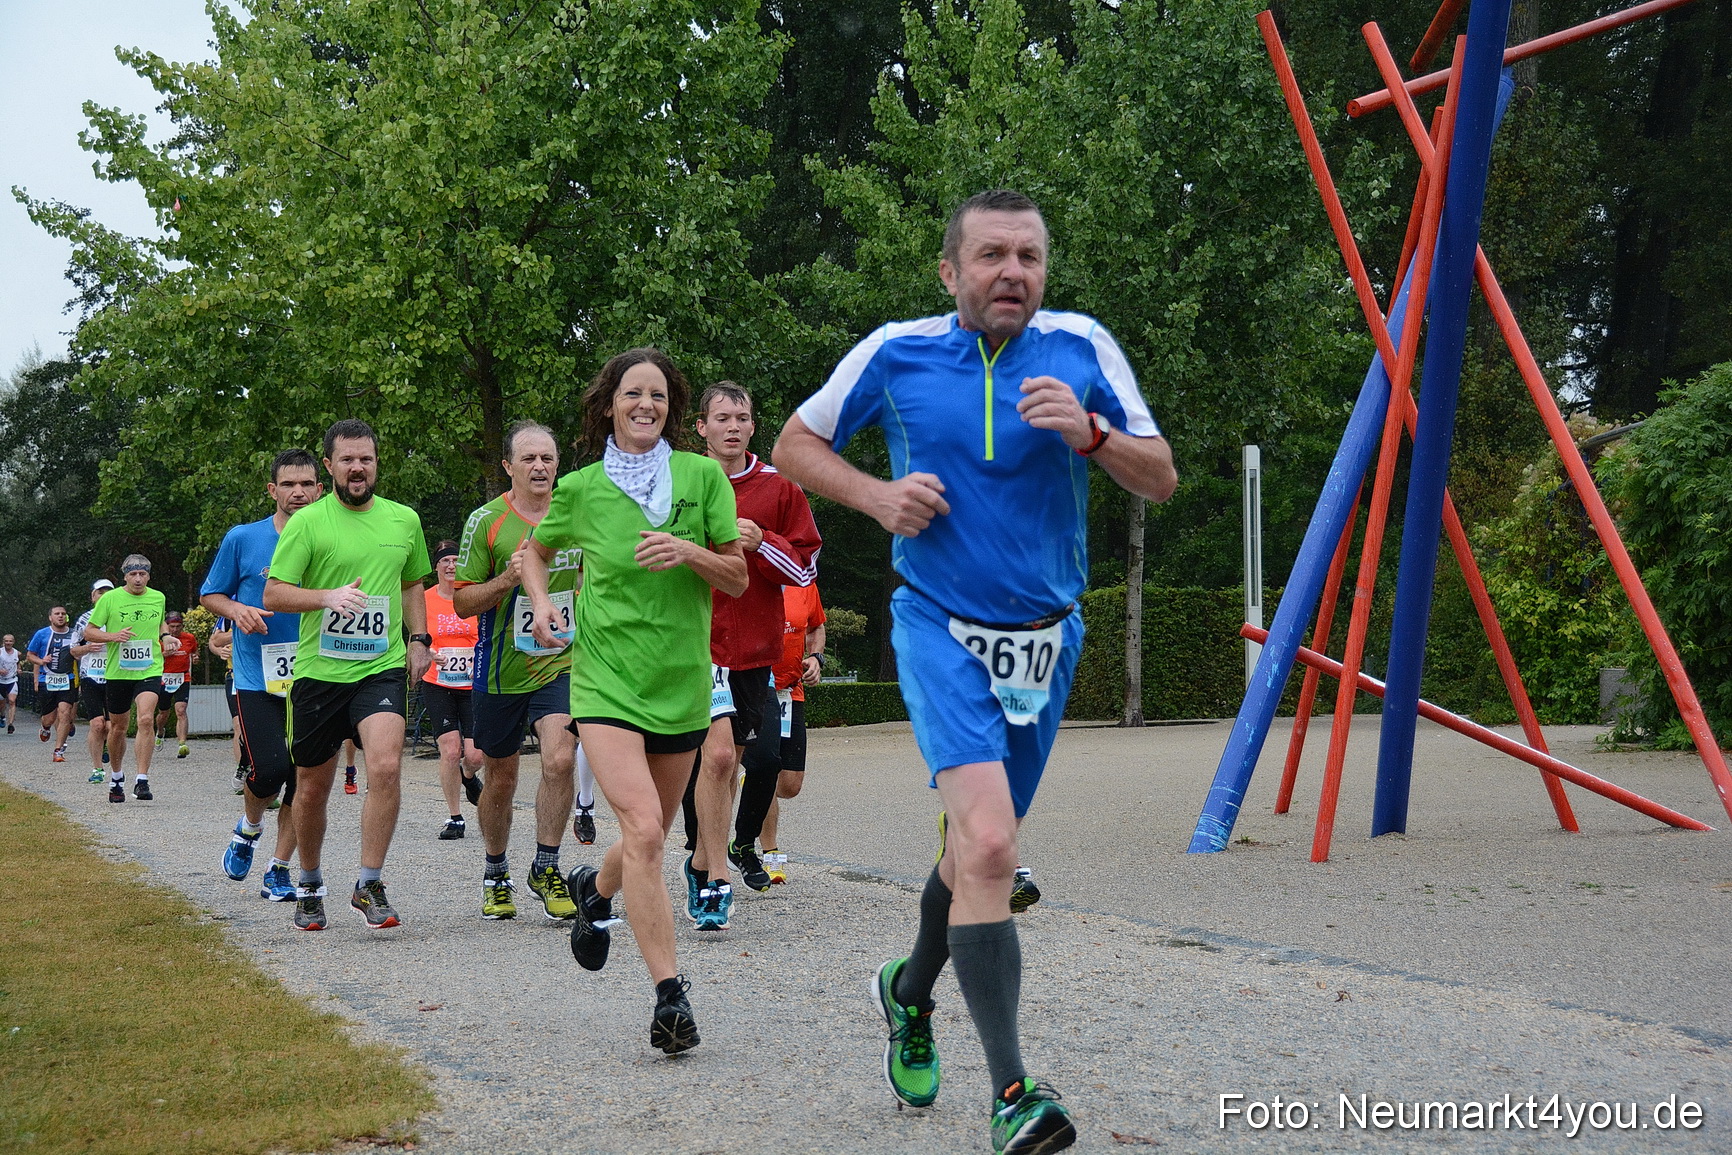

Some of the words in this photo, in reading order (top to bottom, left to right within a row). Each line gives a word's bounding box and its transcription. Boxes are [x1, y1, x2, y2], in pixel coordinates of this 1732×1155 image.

[671, 529, 692, 537] GISELA
[327, 610, 385, 636] 2248
[437, 622, 471, 636] FAST
[334, 639, 375, 651] Christian
[122, 647, 151, 660] 3054
[48, 676, 68, 685] 2098
[164, 677, 182, 686] 2614
